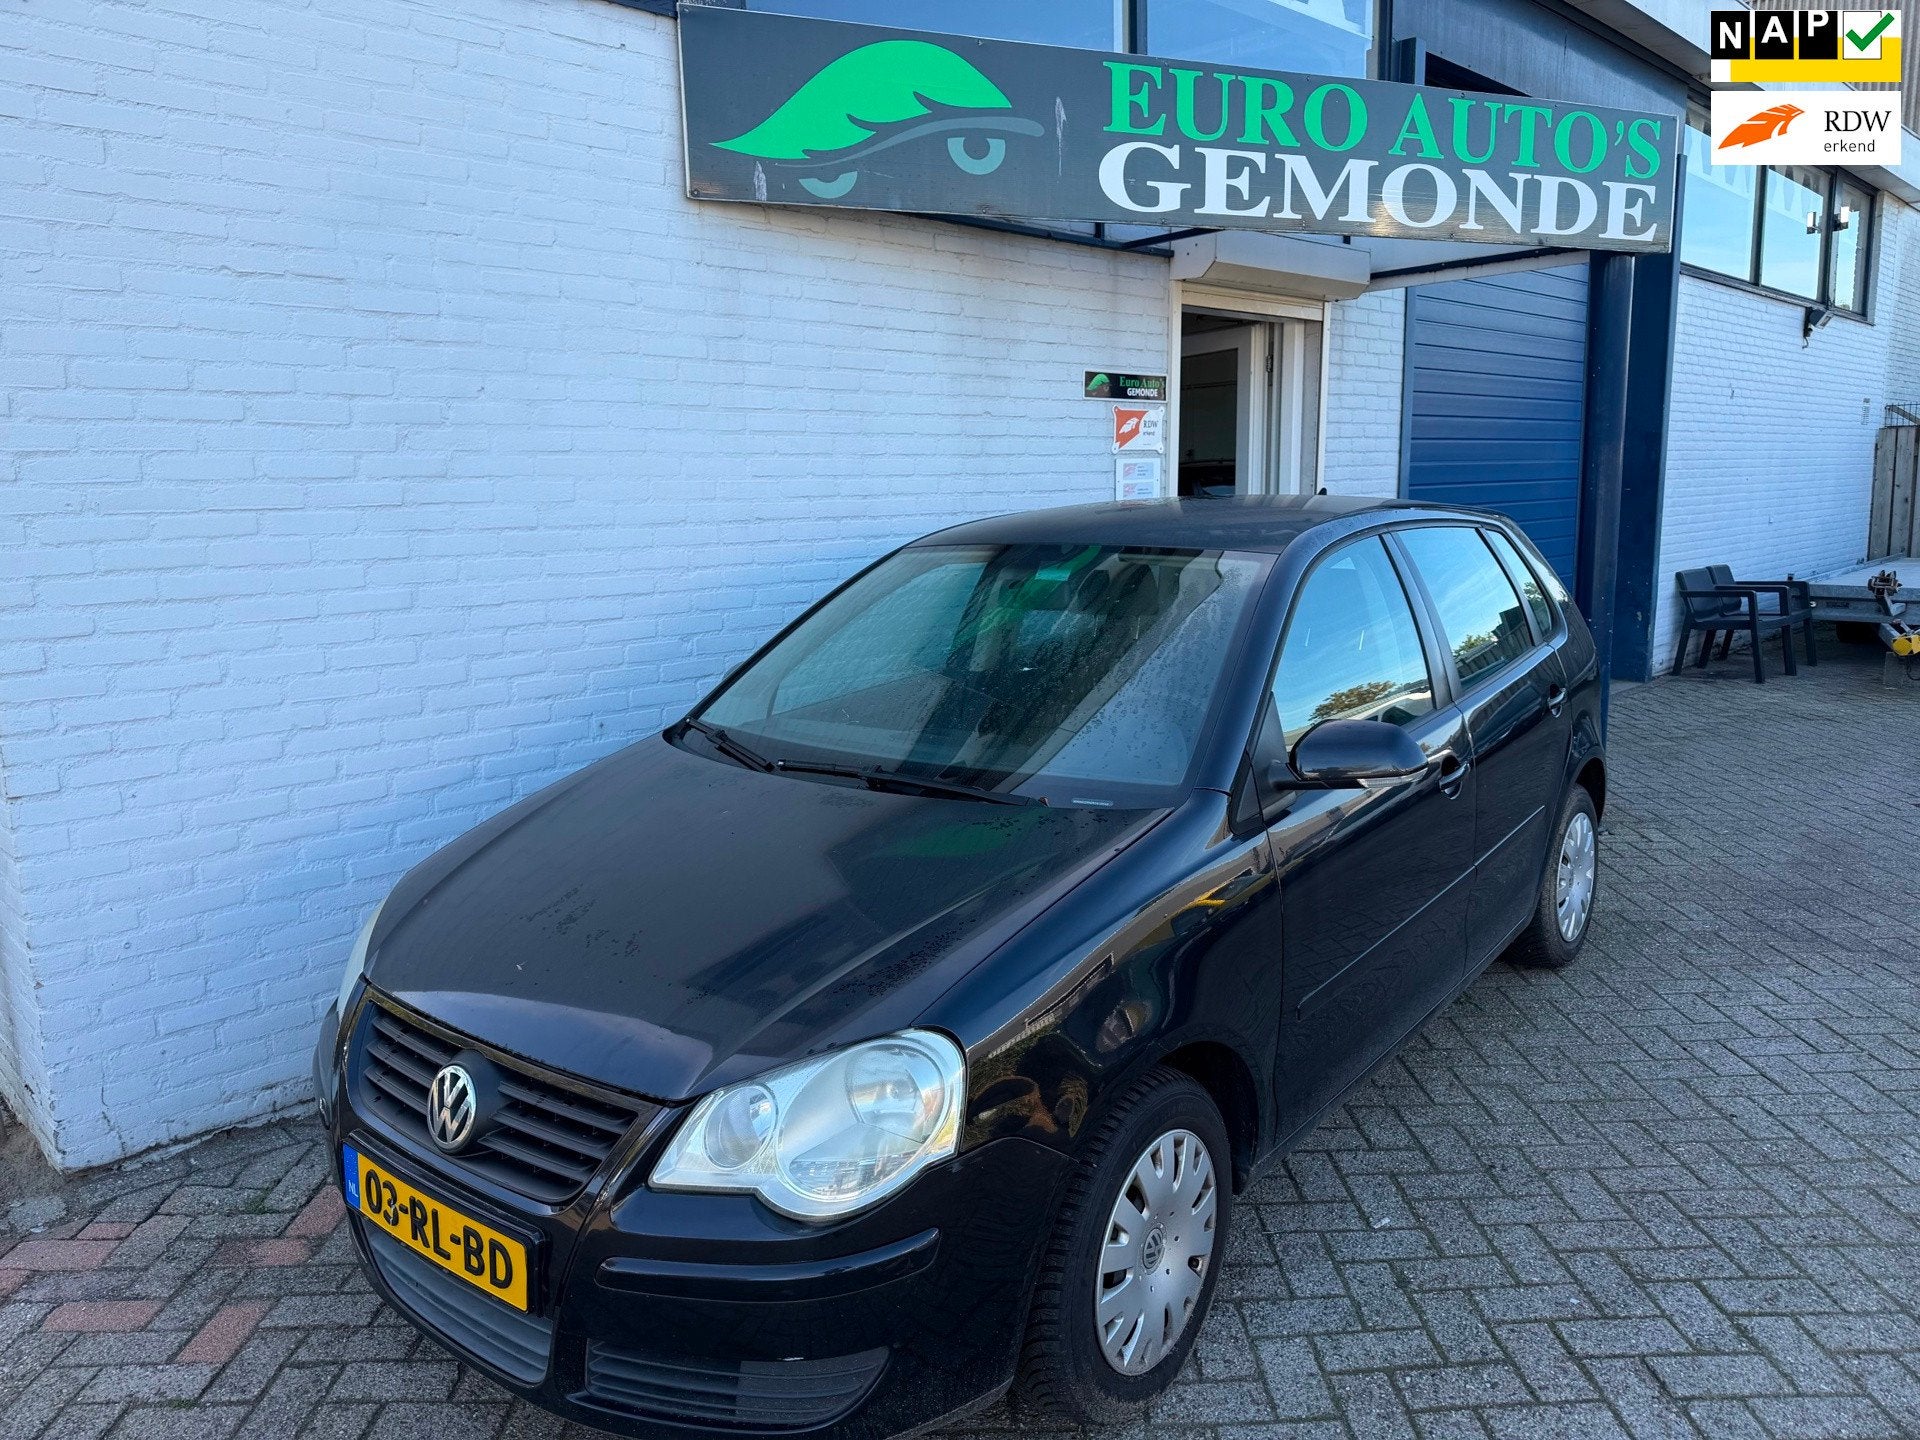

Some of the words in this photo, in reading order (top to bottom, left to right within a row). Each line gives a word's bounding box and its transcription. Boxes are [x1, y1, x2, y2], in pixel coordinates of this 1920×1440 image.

[1103, 60, 1369, 152] EURO
[1388, 93, 1661, 179] AUTO'S
[1099, 141, 1658, 242] GEMONDE
[1119, 376, 1140, 388] Euro
[1126, 387, 1158, 397] GEMONDE
[1143, 420, 1158, 428] RDW
[348, 1180, 359, 1198] NL
[365, 1169, 513, 1289] 03-RL-BD
